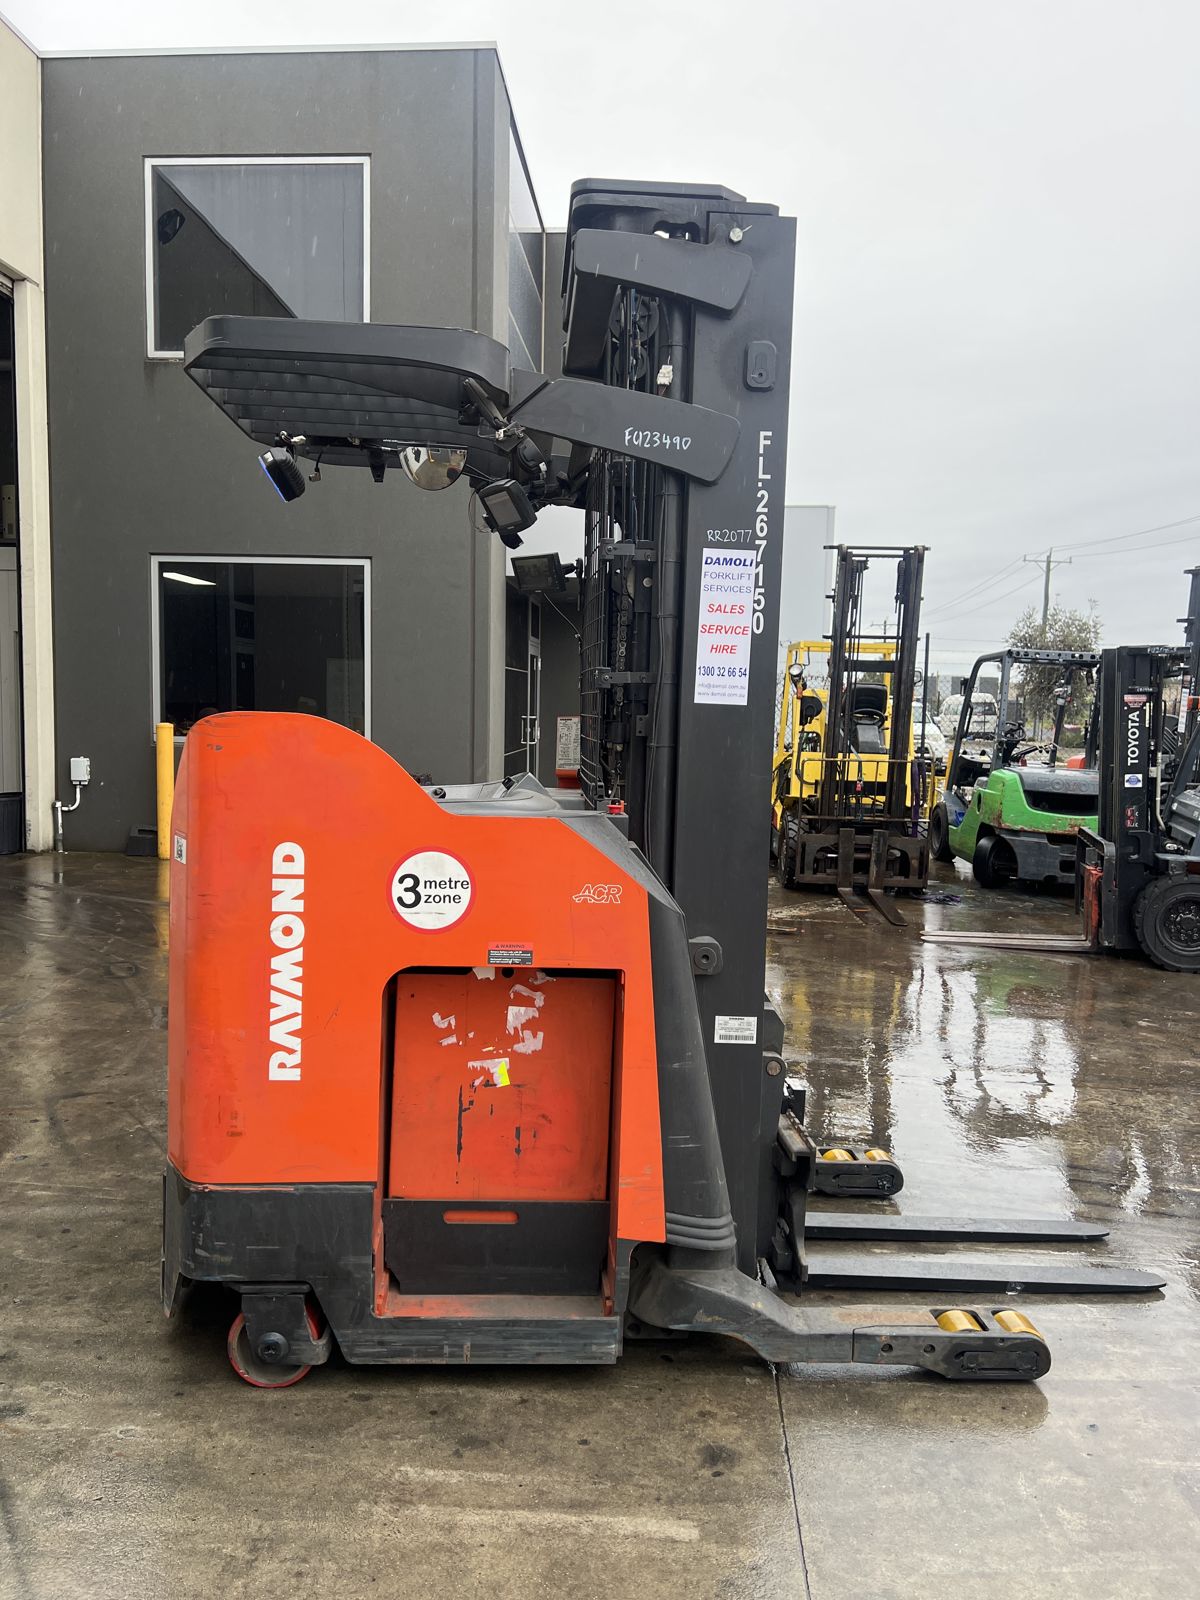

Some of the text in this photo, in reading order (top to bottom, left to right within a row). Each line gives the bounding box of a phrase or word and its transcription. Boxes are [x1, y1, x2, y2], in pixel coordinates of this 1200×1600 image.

[706, 529, 752, 543] RR2077
[704, 556, 754, 567] DAMOLI
[703, 571, 752, 580] FORKLIFT
[703, 584, 752, 593] SERVICES
[707, 603, 745, 614] SALES
[700, 624, 750, 636] SERVICE
[709, 644, 737, 654] HIRE
[698, 666, 747, 678] 1300 32 66 54
[1127, 710, 1140, 767] TOYOTA
[1037, 777, 1099, 794] TOYOT
[396, 873, 470, 909] 3 metre
[572, 884, 623, 904] ACR
[423, 894, 462, 904] zone
[268, 841, 305, 1081] RAYMOND
